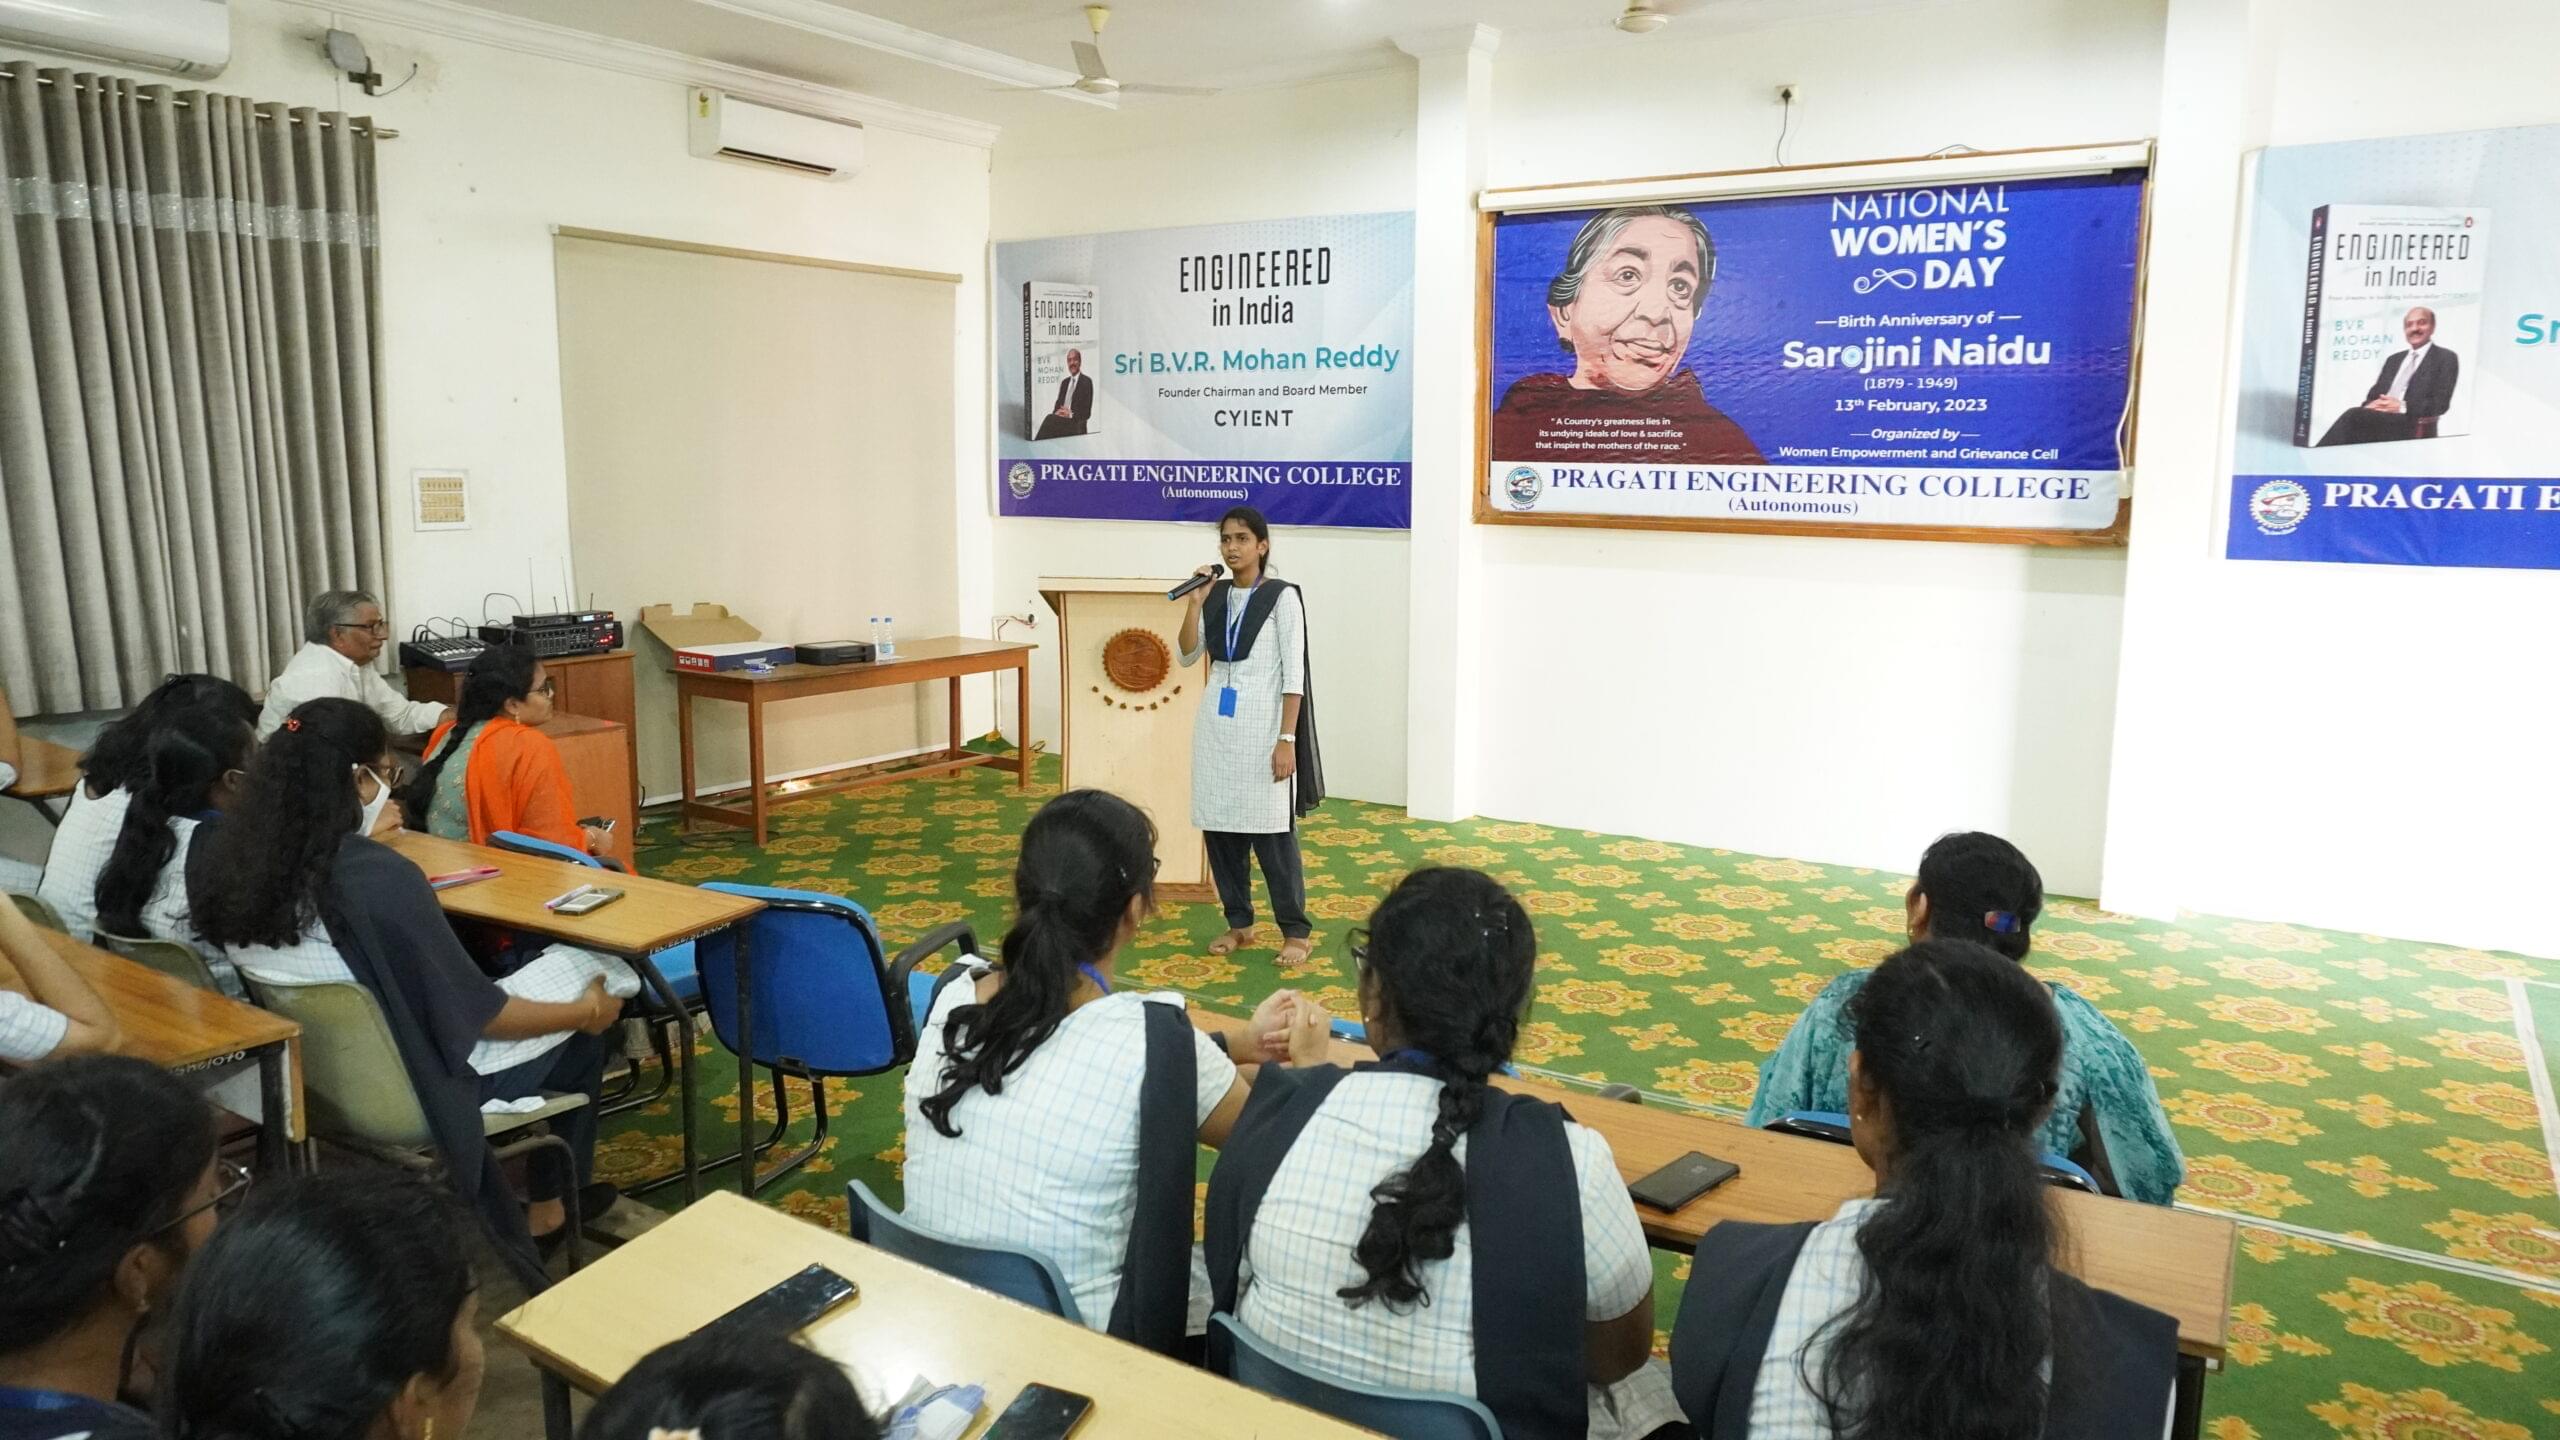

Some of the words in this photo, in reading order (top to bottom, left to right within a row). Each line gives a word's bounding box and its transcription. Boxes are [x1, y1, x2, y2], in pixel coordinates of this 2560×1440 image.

[1831, 185, 2009, 222] NATIONAL
[1830, 219, 2007, 257] WOMEN'S
[2336, 233, 2470, 260] ENGINEERED
[1180, 247, 1331, 292] ENGINEERED
[1923, 256, 2005, 289] DAY
[2364, 265, 2383, 287] in
[2389, 265, 2437, 286] India
[1034, 300, 1093, 319] ENGINEERED
[1213, 298, 1230, 326] in
[1239, 295, 1293, 325] India
[1838, 315, 1875, 328] Birth
[1879, 313, 1973, 328] Anniversary
[1977, 311, 1995, 324] of
[2335, 319, 2364, 331] BVR
[1048, 322, 1057, 336] in
[1058, 322, 1080, 336] India
[2333, 334, 2393, 346] MOHAN
[1114, 352, 1143, 374] Sri
[1150, 352, 1215, 373] B.V.R.
[1223, 348, 1306, 371] Mohan
[1316, 344, 1400, 373] Reddy
[1782, 336, 1921, 374] Sarojini
[1933, 334, 2051, 366] Naidu
[2332, 349, 2382, 361] REDDY
[1158, 387, 1200, 399] Founder
[1203, 386, 1255, 397] Chairman
[1258, 386, 1279, 397] and
[1283, 385, 1315, 397] Board
[1319, 384, 1368, 396] Member
[1864, 378, 1904, 391] (1879
[1917, 377, 1958, 391] 1949)
[1835, 399, 1864, 412] 13th
[1868, 399, 1941, 414] February,
[1944, 399, 1988, 412] 2023
[1214, 410, 1294, 427] CYIENT
[1564, 417, 1602, 427] Country's
[1604, 418, 1645, 427] greatness
[1646, 417, 1660, 425] lies
[1662, 417, 1671, 425] in
[1539, 430, 1549, 438] its
[1550, 430, 1583, 439] undying
[1585, 430, 1609, 438] ideals
[1610, 430, 1619, 438] of
[1620, 430, 1638, 438] love
[1639, 430, 1645, 438] &
[1647, 429, 1683, 438] sacrifice
[1871, 429, 1939, 442] Organized
[1942, 429, 1960, 442] by
[1535, 441, 1552, 449] that
[1553, 441, 1580, 451] inspire
[1582, 442, 1595, 450] the
[1597, 442, 1633, 450] mothers
[1634, 442, 1644, 450] of
[1645, 442, 1659, 450] the
[1779, 446, 1828, 457] Women
[1831, 447, 1928, 460] Empowerment
[1931, 448, 1957, 459] and
[1960, 448, 2029, 460] Grievance
[2031, 448, 2058, 460] Cell
[1040, 464, 1126, 483] PRAGATI
[1133, 465, 1281, 485] ENGINEERING
[1287, 466, 1402, 486] COLLEGE
[1551, 468, 1677, 490] PRAGATI
[1686, 470, 1908, 497] ENGINEERING
[1920, 475, 2090, 500] COLLEGE
[1161, 486, 1249, 502] (Autonomous)
[2322, 483, 2528, 511] PRAGATI
[1728, 497, 1859, 515] (Autonomous)
